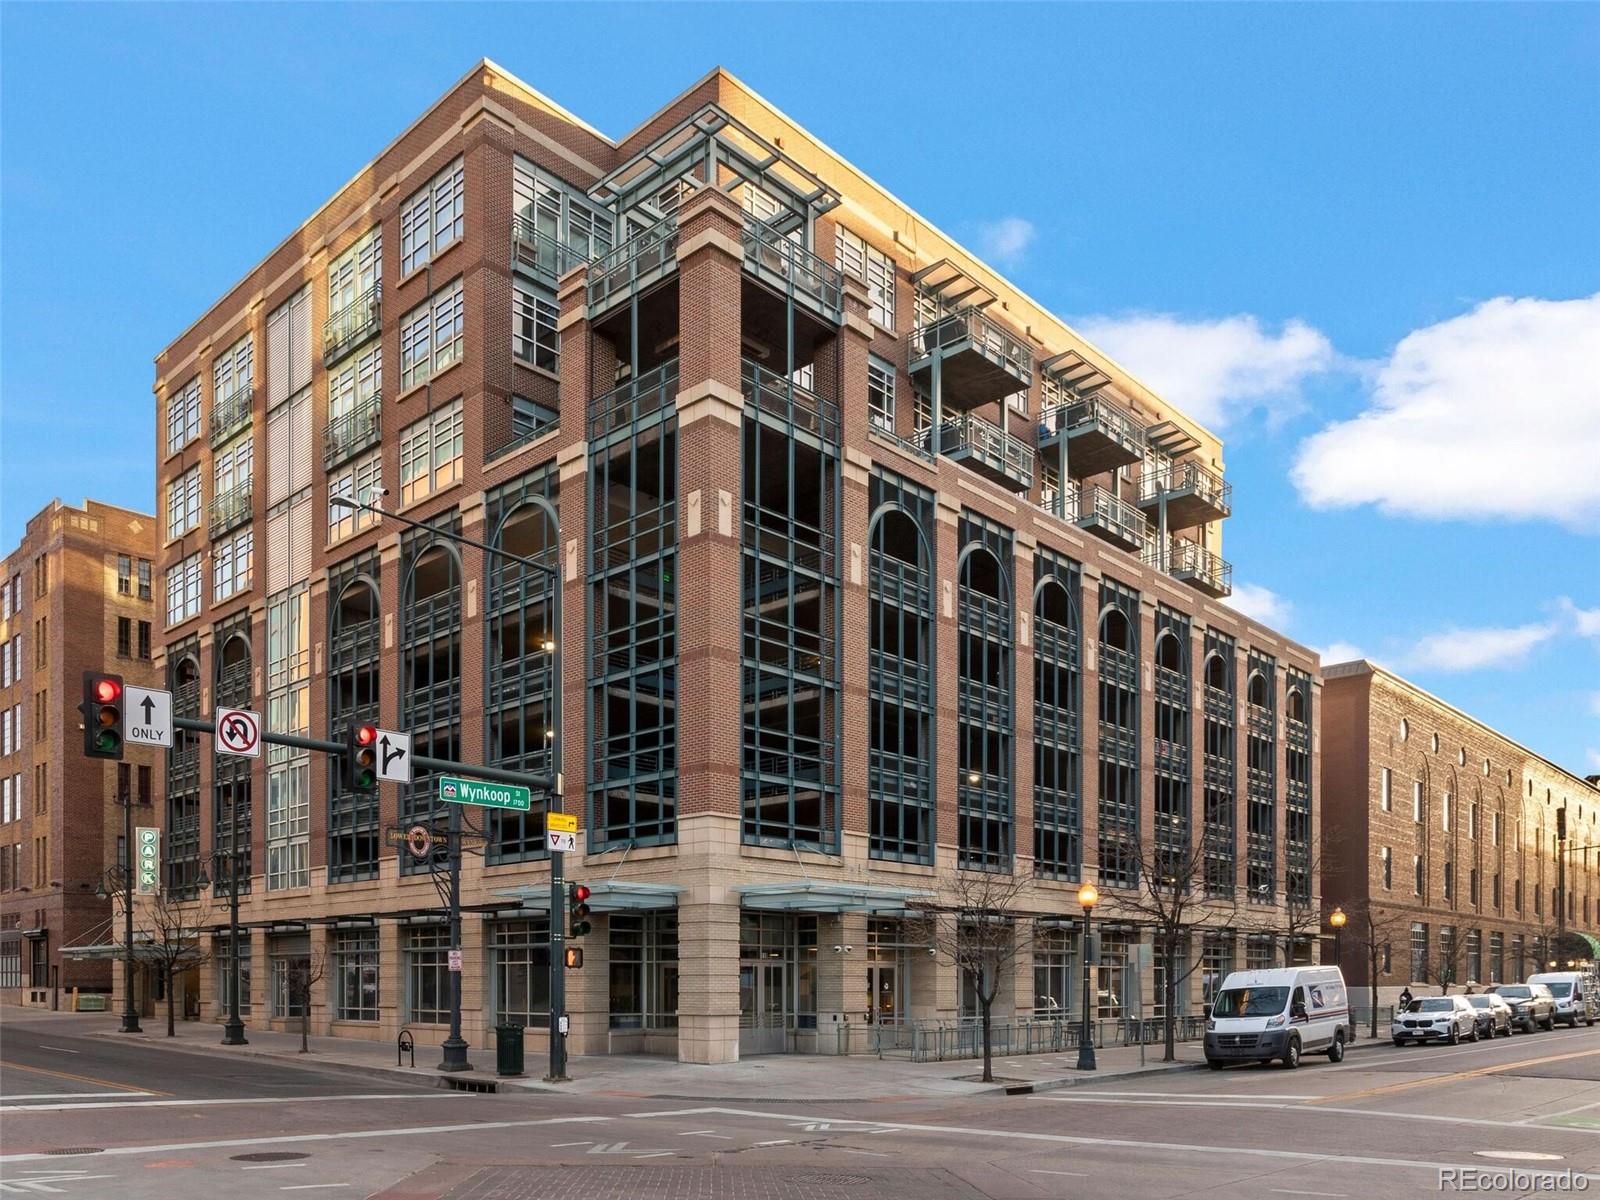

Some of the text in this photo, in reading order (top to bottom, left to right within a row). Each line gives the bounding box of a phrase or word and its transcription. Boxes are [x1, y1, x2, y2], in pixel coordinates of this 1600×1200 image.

[132, 727, 164, 740] ONLY
[460, 783, 511, 805] Wynkoop
[512, 799, 525, 807] 1700
[143, 831, 155, 884] PARK
